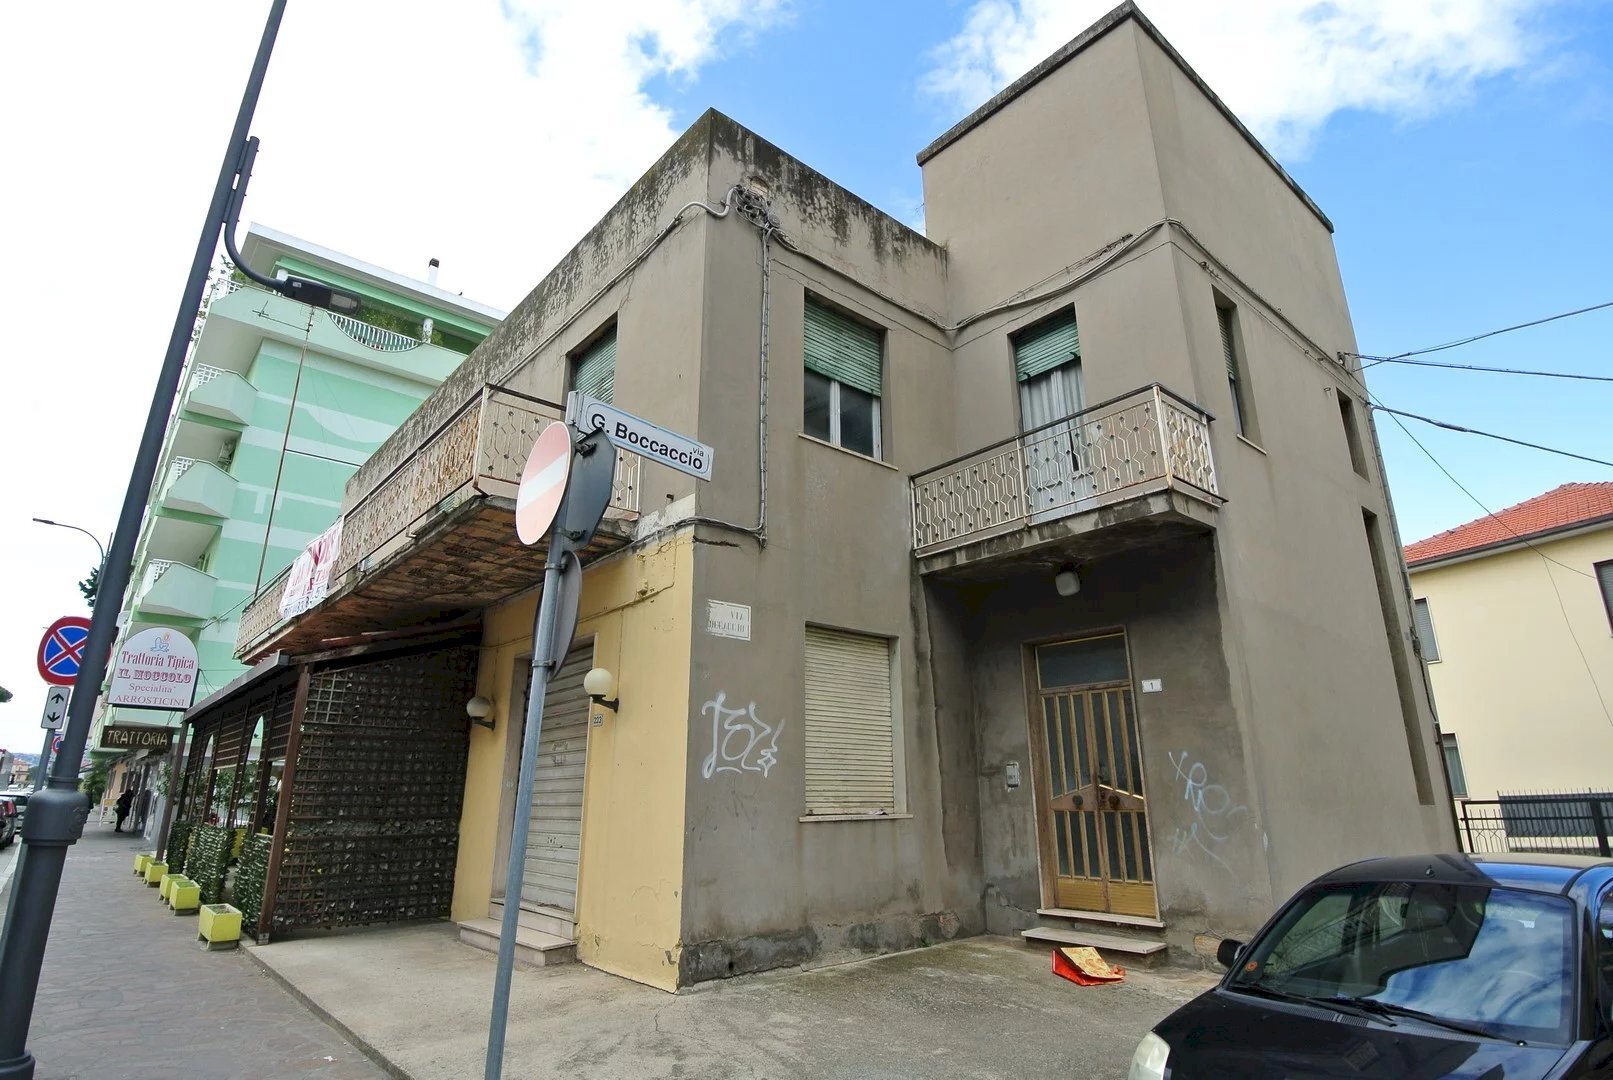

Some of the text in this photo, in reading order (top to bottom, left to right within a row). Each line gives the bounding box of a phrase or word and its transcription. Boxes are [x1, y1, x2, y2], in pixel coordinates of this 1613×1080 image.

[591, 413, 703, 469] G. Boccaccio
[692, 446, 704, 457] via
[122, 651, 195, 670] Trattoria Tipica
[117, 669, 192, 683] IL MOCCOLO
[115, 695, 185, 706] ARROSTICINI
[108, 731, 168, 745] TRATTORIA
